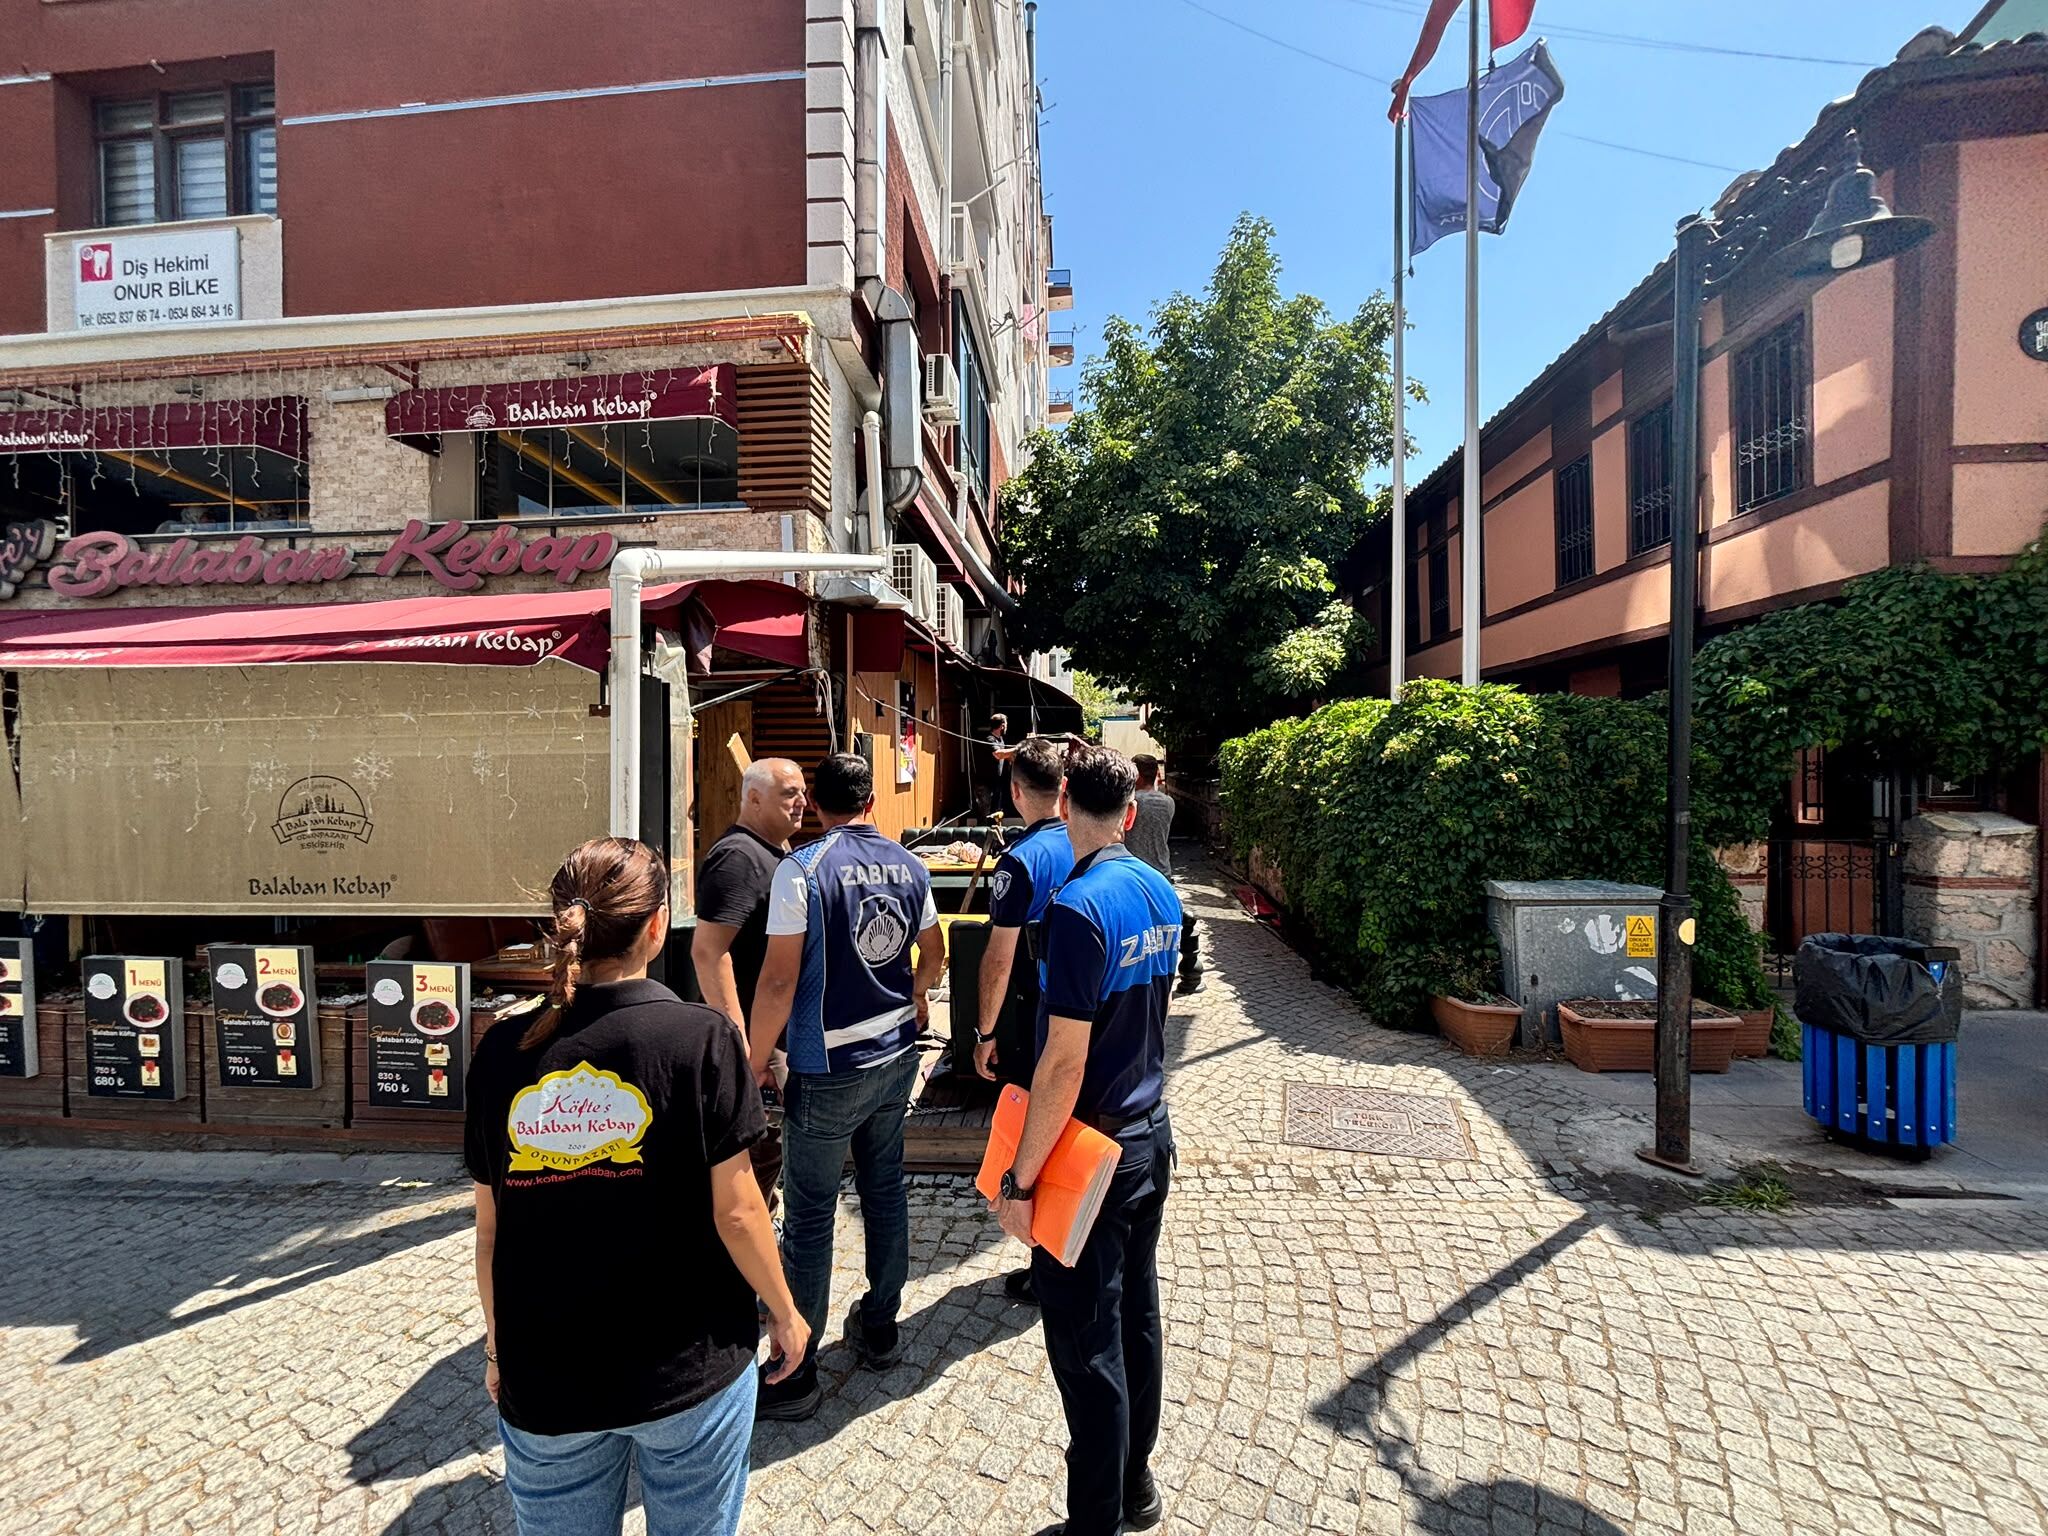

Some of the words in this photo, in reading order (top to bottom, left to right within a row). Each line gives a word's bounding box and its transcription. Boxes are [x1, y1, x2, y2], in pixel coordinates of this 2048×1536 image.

[123, 260, 148, 278] Diş
[154, 254, 209, 274] Hekimi
[114, 283, 163, 300] ONUR
[169, 276, 219, 296] BİLKE
[96, 313, 116, 326] 0552
[119, 311, 134, 323] 837
[136, 310, 147, 322] 66
[150, 309, 160, 321] 74
[168, 307, 188, 320] 0534
[209, 305, 220, 317] 34
[223, 304, 233, 316] 16
[508, 400, 587, 422] Balaban
[0, 432, 46, 446] alaban
[48, 531, 353, 598] Balaban
[375, 519, 615, 591] Kebap
[840, 863, 913, 887] ZABITA
[248, 876, 327, 896] Balaban
[258, 958, 272, 975] 2
[272, 967, 297, 976] MENÜ
[129, 969, 137, 986] 1
[415, 974, 428, 992] 3
[430, 985, 454, 993] MENÜ
[376, 1036, 404, 1044] Balaban
[405, 1037, 424, 1045] Köfte
[228, 1066, 248, 1076] 710
[94, 1076, 115, 1086] 680
[377, 1082, 398, 1093] 760
[542, 1094, 612, 1118] Köfte's
[516, 1119, 582, 1136] Balaban
[588, 1118, 636, 1135] Kebap
[530, 1142, 622, 1166] ODUNPAZARI
